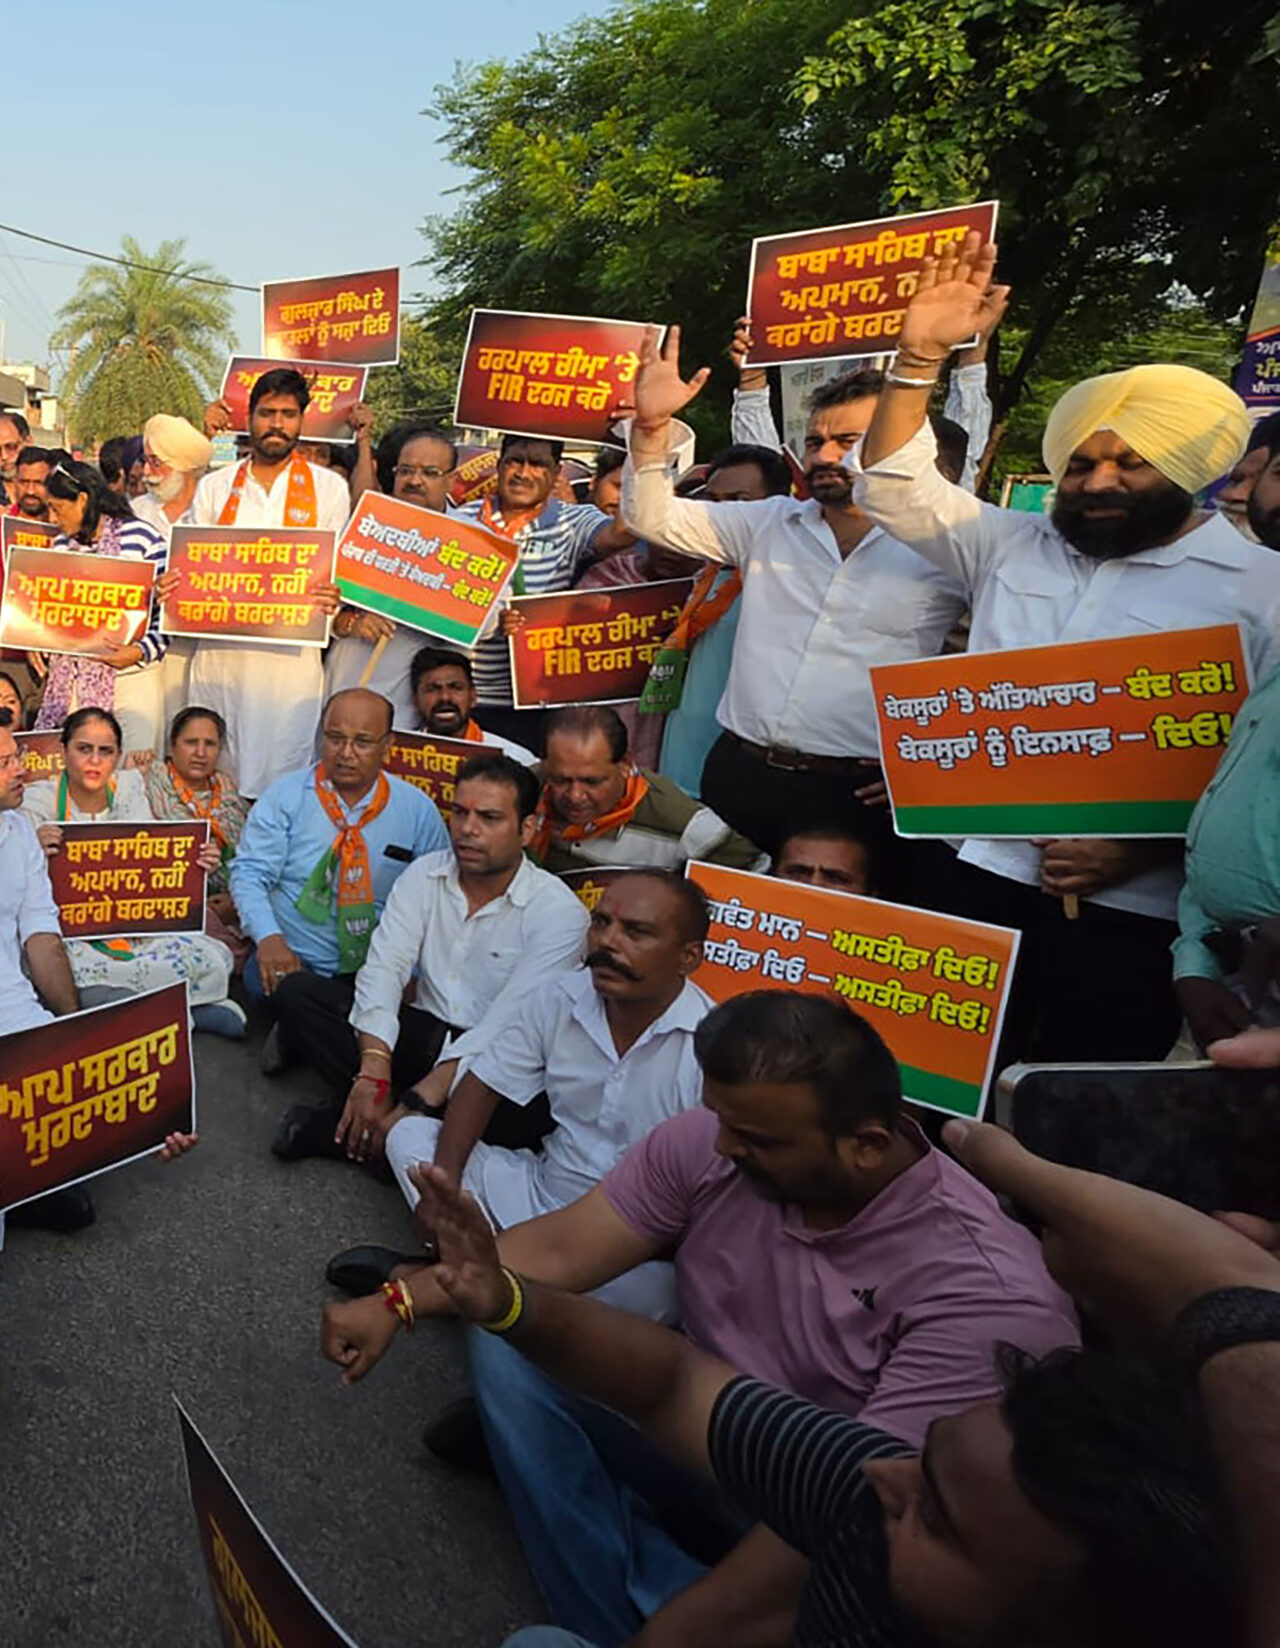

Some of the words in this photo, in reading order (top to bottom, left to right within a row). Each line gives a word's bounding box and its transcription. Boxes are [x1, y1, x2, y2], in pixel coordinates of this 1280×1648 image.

[777, 247, 841, 279] ਬਾਬਾ
[843, 230, 930, 269] ਸਾਹਿਬ
[372, 287, 384, 310] ਦੇ
[780, 276, 888, 312] ਅਪਮਾਨ,
[766, 311, 840, 348] ਕਰਾਂਗੇ
[843, 309, 907, 339] ਬਰਦ
[555, 347, 609, 379] ਚੀਮਾ
[487, 373, 525, 402] FIR
[526, 381, 574, 408] ਦਰਜ
[576, 382, 613, 410] ਕਰੋ
[188, 543, 233, 563] ਬਾਬਾ
[235, 538, 291, 565] ਸਾਹਿਬ
[295, 544, 319, 565] ਦਾ
[437, 539, 470, 570] ਬੰਦ
[467, 552, 508, 583] ਕਰੋ!
[18, 574, 68, 602] ਆਪ
[70, 581, 145, 608] ਸਰਕਾਰ
[189, 573, 266, 597] ਅਪਮਾਨ,
[271, 568, 313, 596] ਨਹੀਂ
[177, 596, 230, 620] ਕਰਾਂਗੇ
[607, 612, 657, 641] ਚੀਮਾ
[544, 649, 581, 676] FIR
[585, 647, 634, 672] ਦਰਜ
[1125, 667, 1174, 701] ਬੰਦ
[1178, 660, 1236, 695] ਕਰੋ!
[401, 744, 460, 777] ਸਾਹਿਬ
[66, 840, 112, 862] ਬਾਬਾ
[113, 831, 172, 861] ਸਾਹਿਬ
[173, 835, 195, 858] ਦਾ
[70, 868, 146, 894] ਅਪਮਾਨ,
[151, 862, 189, 889] ਨਹੀਂ
[61, 898, 113, 925] ਕਰਾਂਗੇ
[758, 912, 804, 942] ਮਾਨ
[933, 948, 1000, 990] ਦਿਓ!
[703, 940, 760, 971] ਸਤੀਫ਼ਾ
[762, 950, 807, 984] ਦਿਓ
[930, 991, 991, 1034] ਦਿਓ!
[79, 1022, 179, 1091] ਸਰਕਾਰ
[22, 1071, 160, 1167] ਮੁਰਦਾਬਾਦ
